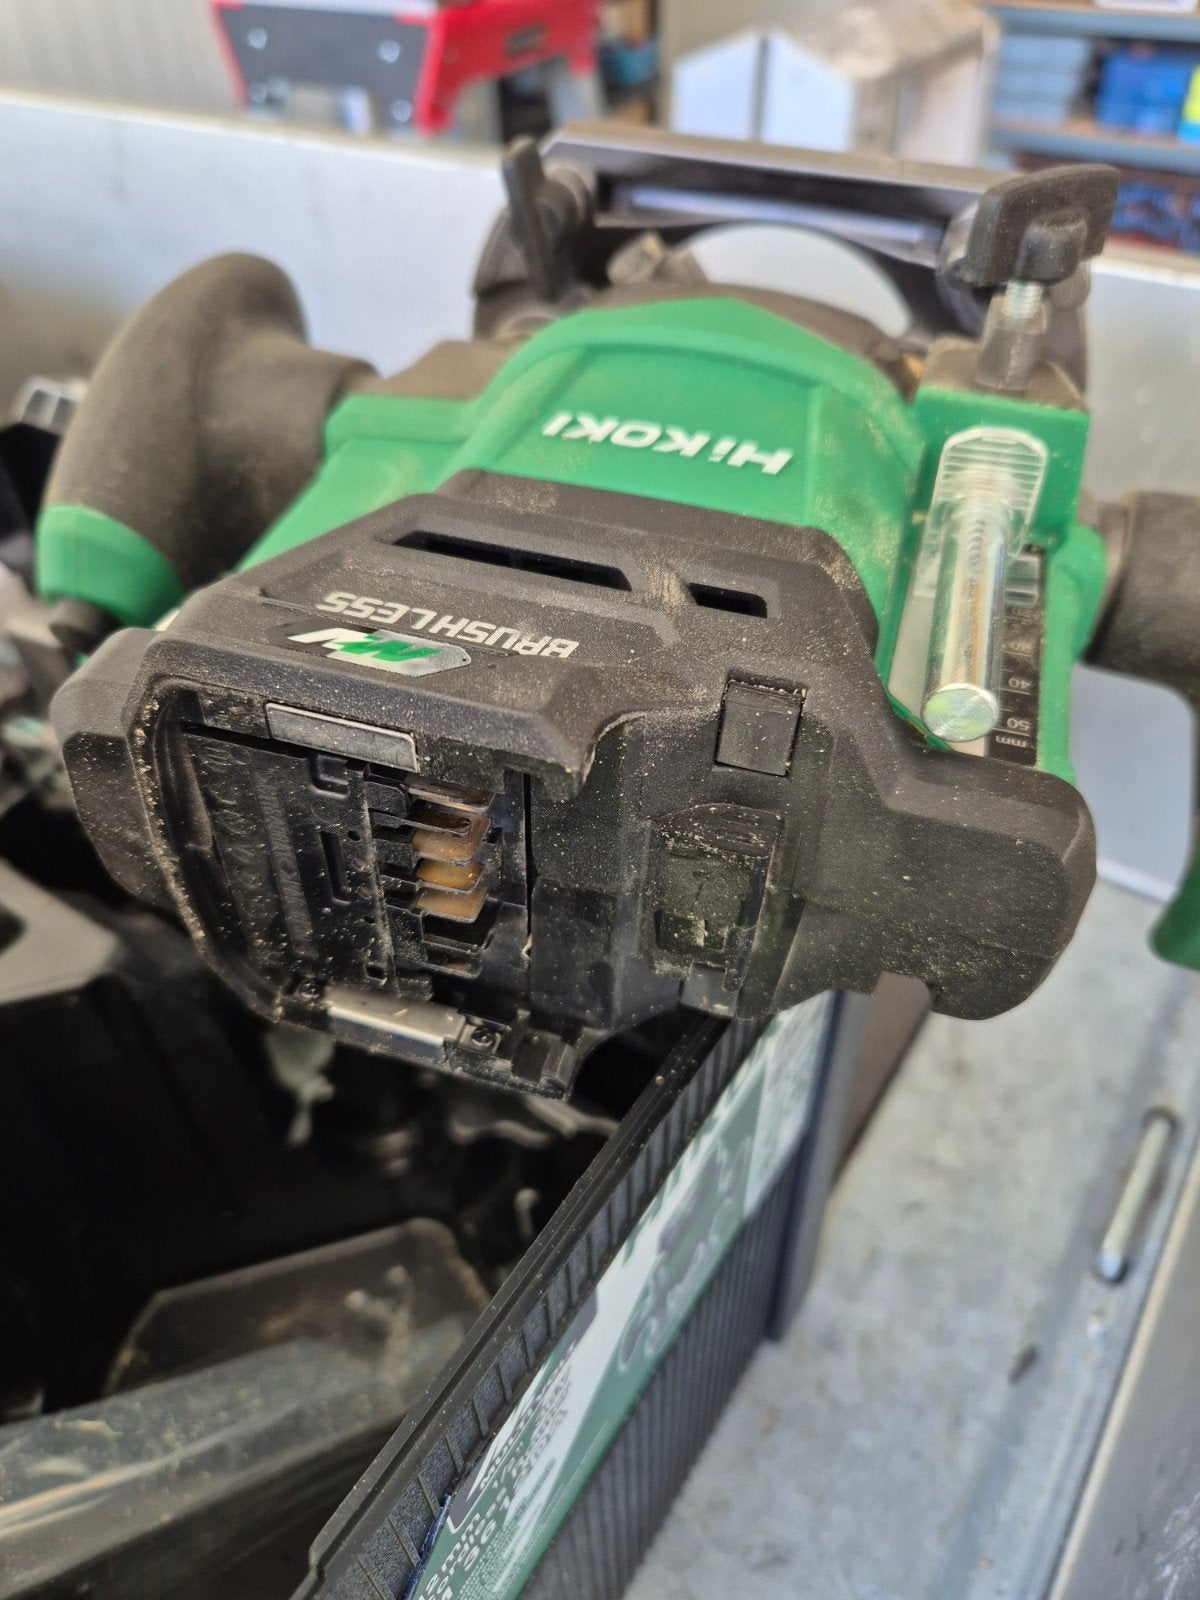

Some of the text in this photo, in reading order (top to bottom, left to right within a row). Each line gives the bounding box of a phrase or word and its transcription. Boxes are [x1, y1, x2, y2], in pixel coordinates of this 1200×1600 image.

[541, 409, 793, 475] HiKOKI
[316, 593, 579, 658] BRUSHLESS
[1008, 677, 1031, 689] 40
[995, 735, 1027, 748] mm
[1006, 717, 1030, 730] 50
[481, 1406, 534, 1489] MULTI
